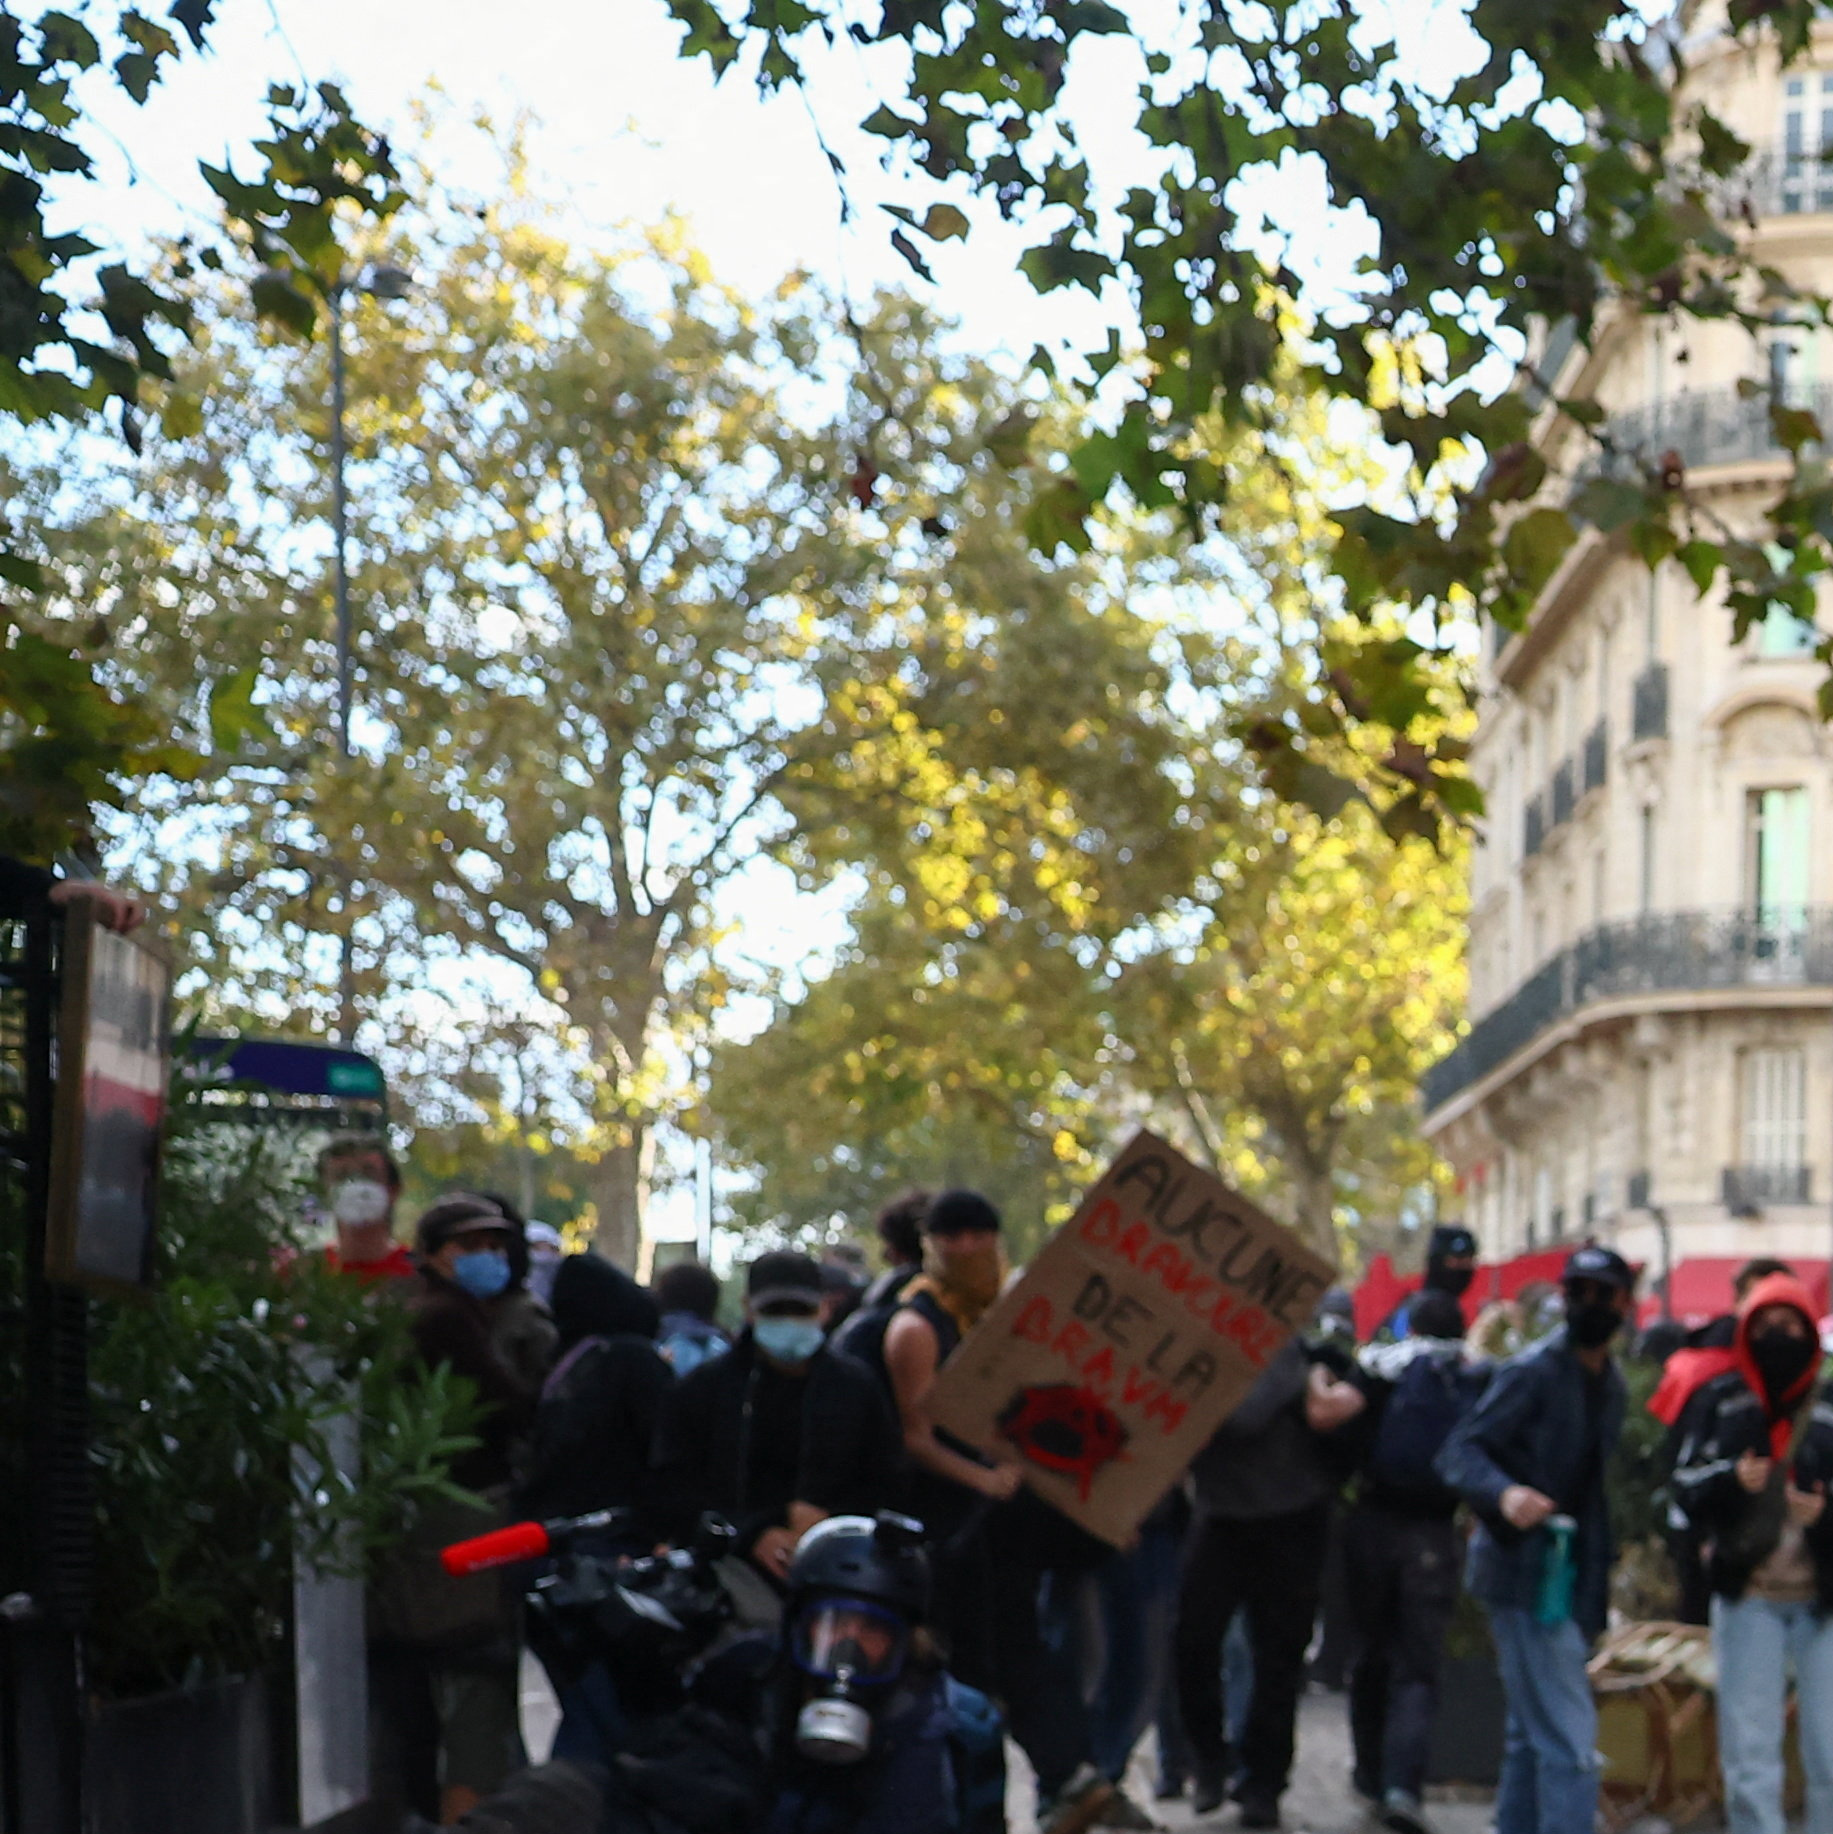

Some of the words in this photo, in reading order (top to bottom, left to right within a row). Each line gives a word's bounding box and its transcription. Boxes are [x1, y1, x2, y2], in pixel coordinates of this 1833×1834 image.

[1113, 1154, 1330, 1328] AUCUNE
[1071, 1272, 1157, 1350] DE
[1145, 1326, 1219, 1398] LA
